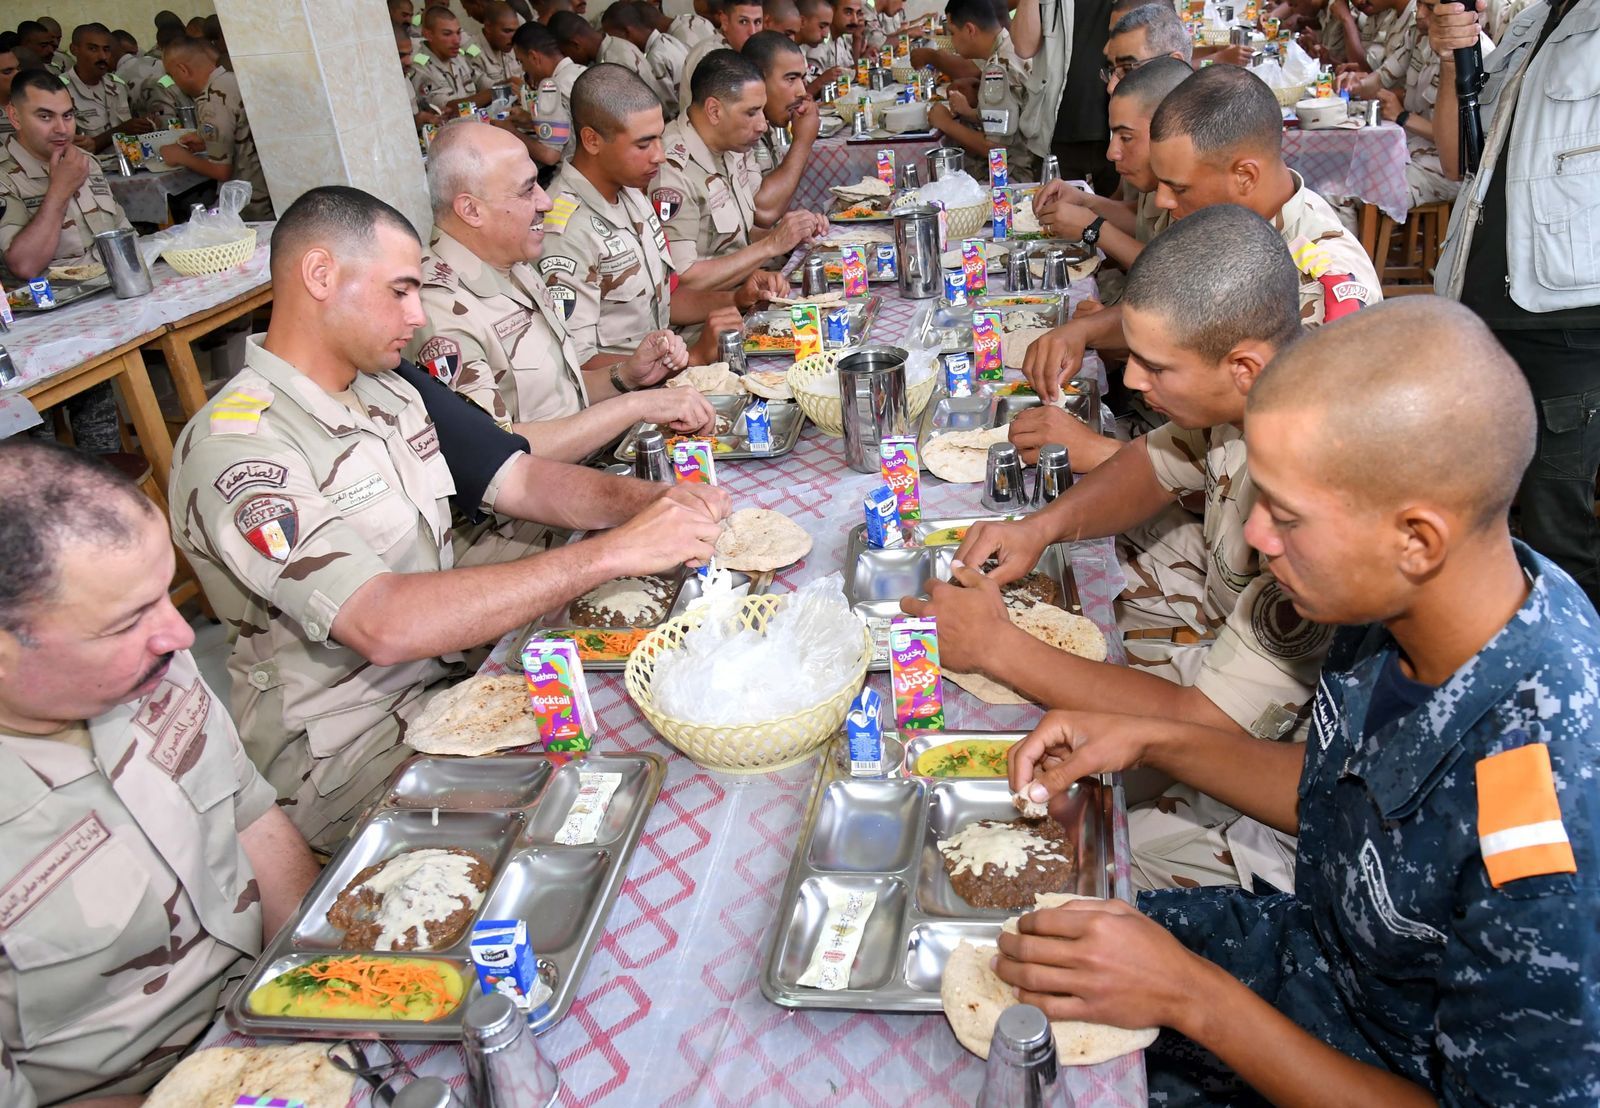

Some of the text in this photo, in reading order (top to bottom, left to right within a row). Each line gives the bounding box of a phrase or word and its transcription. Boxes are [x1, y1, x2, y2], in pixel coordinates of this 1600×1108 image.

[542, 256, 572, 270] المظلات
[243, 504, 286, 528] EGYPT
[531, 673, 558, 683] Bekhero
[899, 667, 935, 692] كوكتيل
[533, 694, 571, 706] Cocktail
